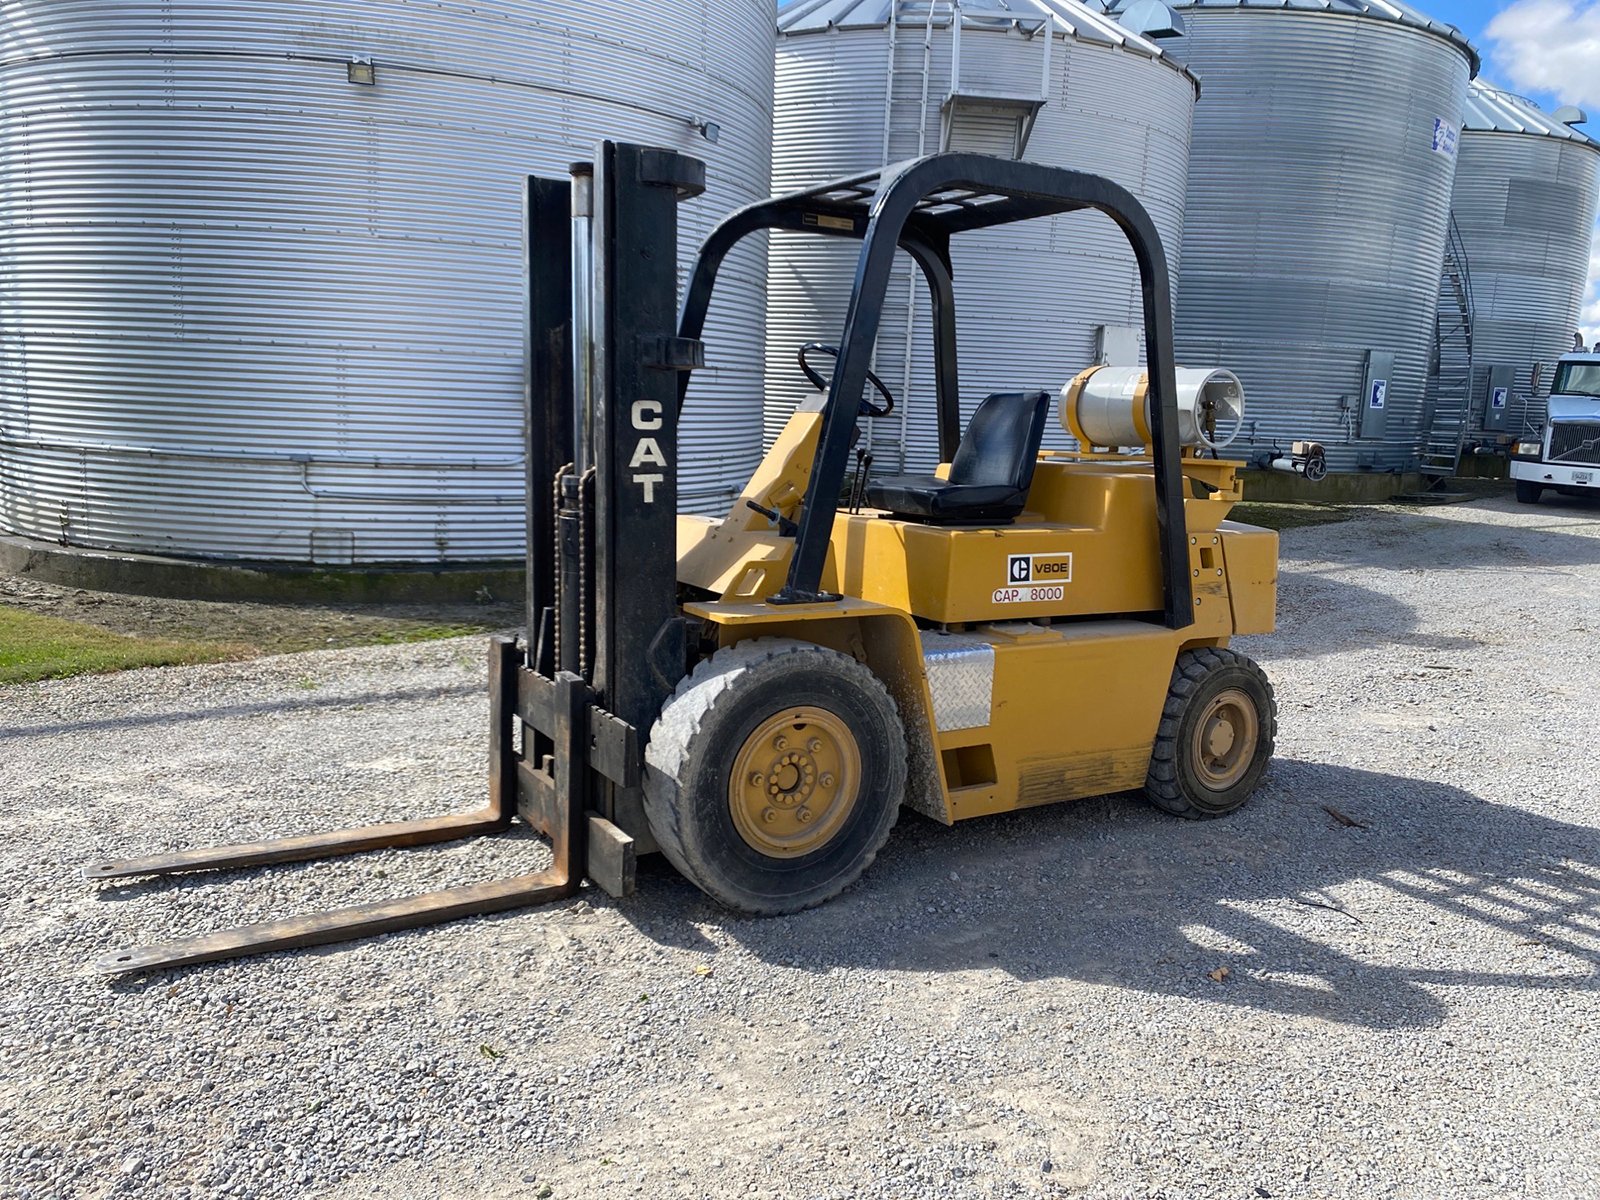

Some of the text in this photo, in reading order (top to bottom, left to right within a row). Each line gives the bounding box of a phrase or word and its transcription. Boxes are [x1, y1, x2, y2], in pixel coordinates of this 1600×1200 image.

[629, 400, 667, 503] CAT
[994, 587, 1062, 602] CAP. 8000
